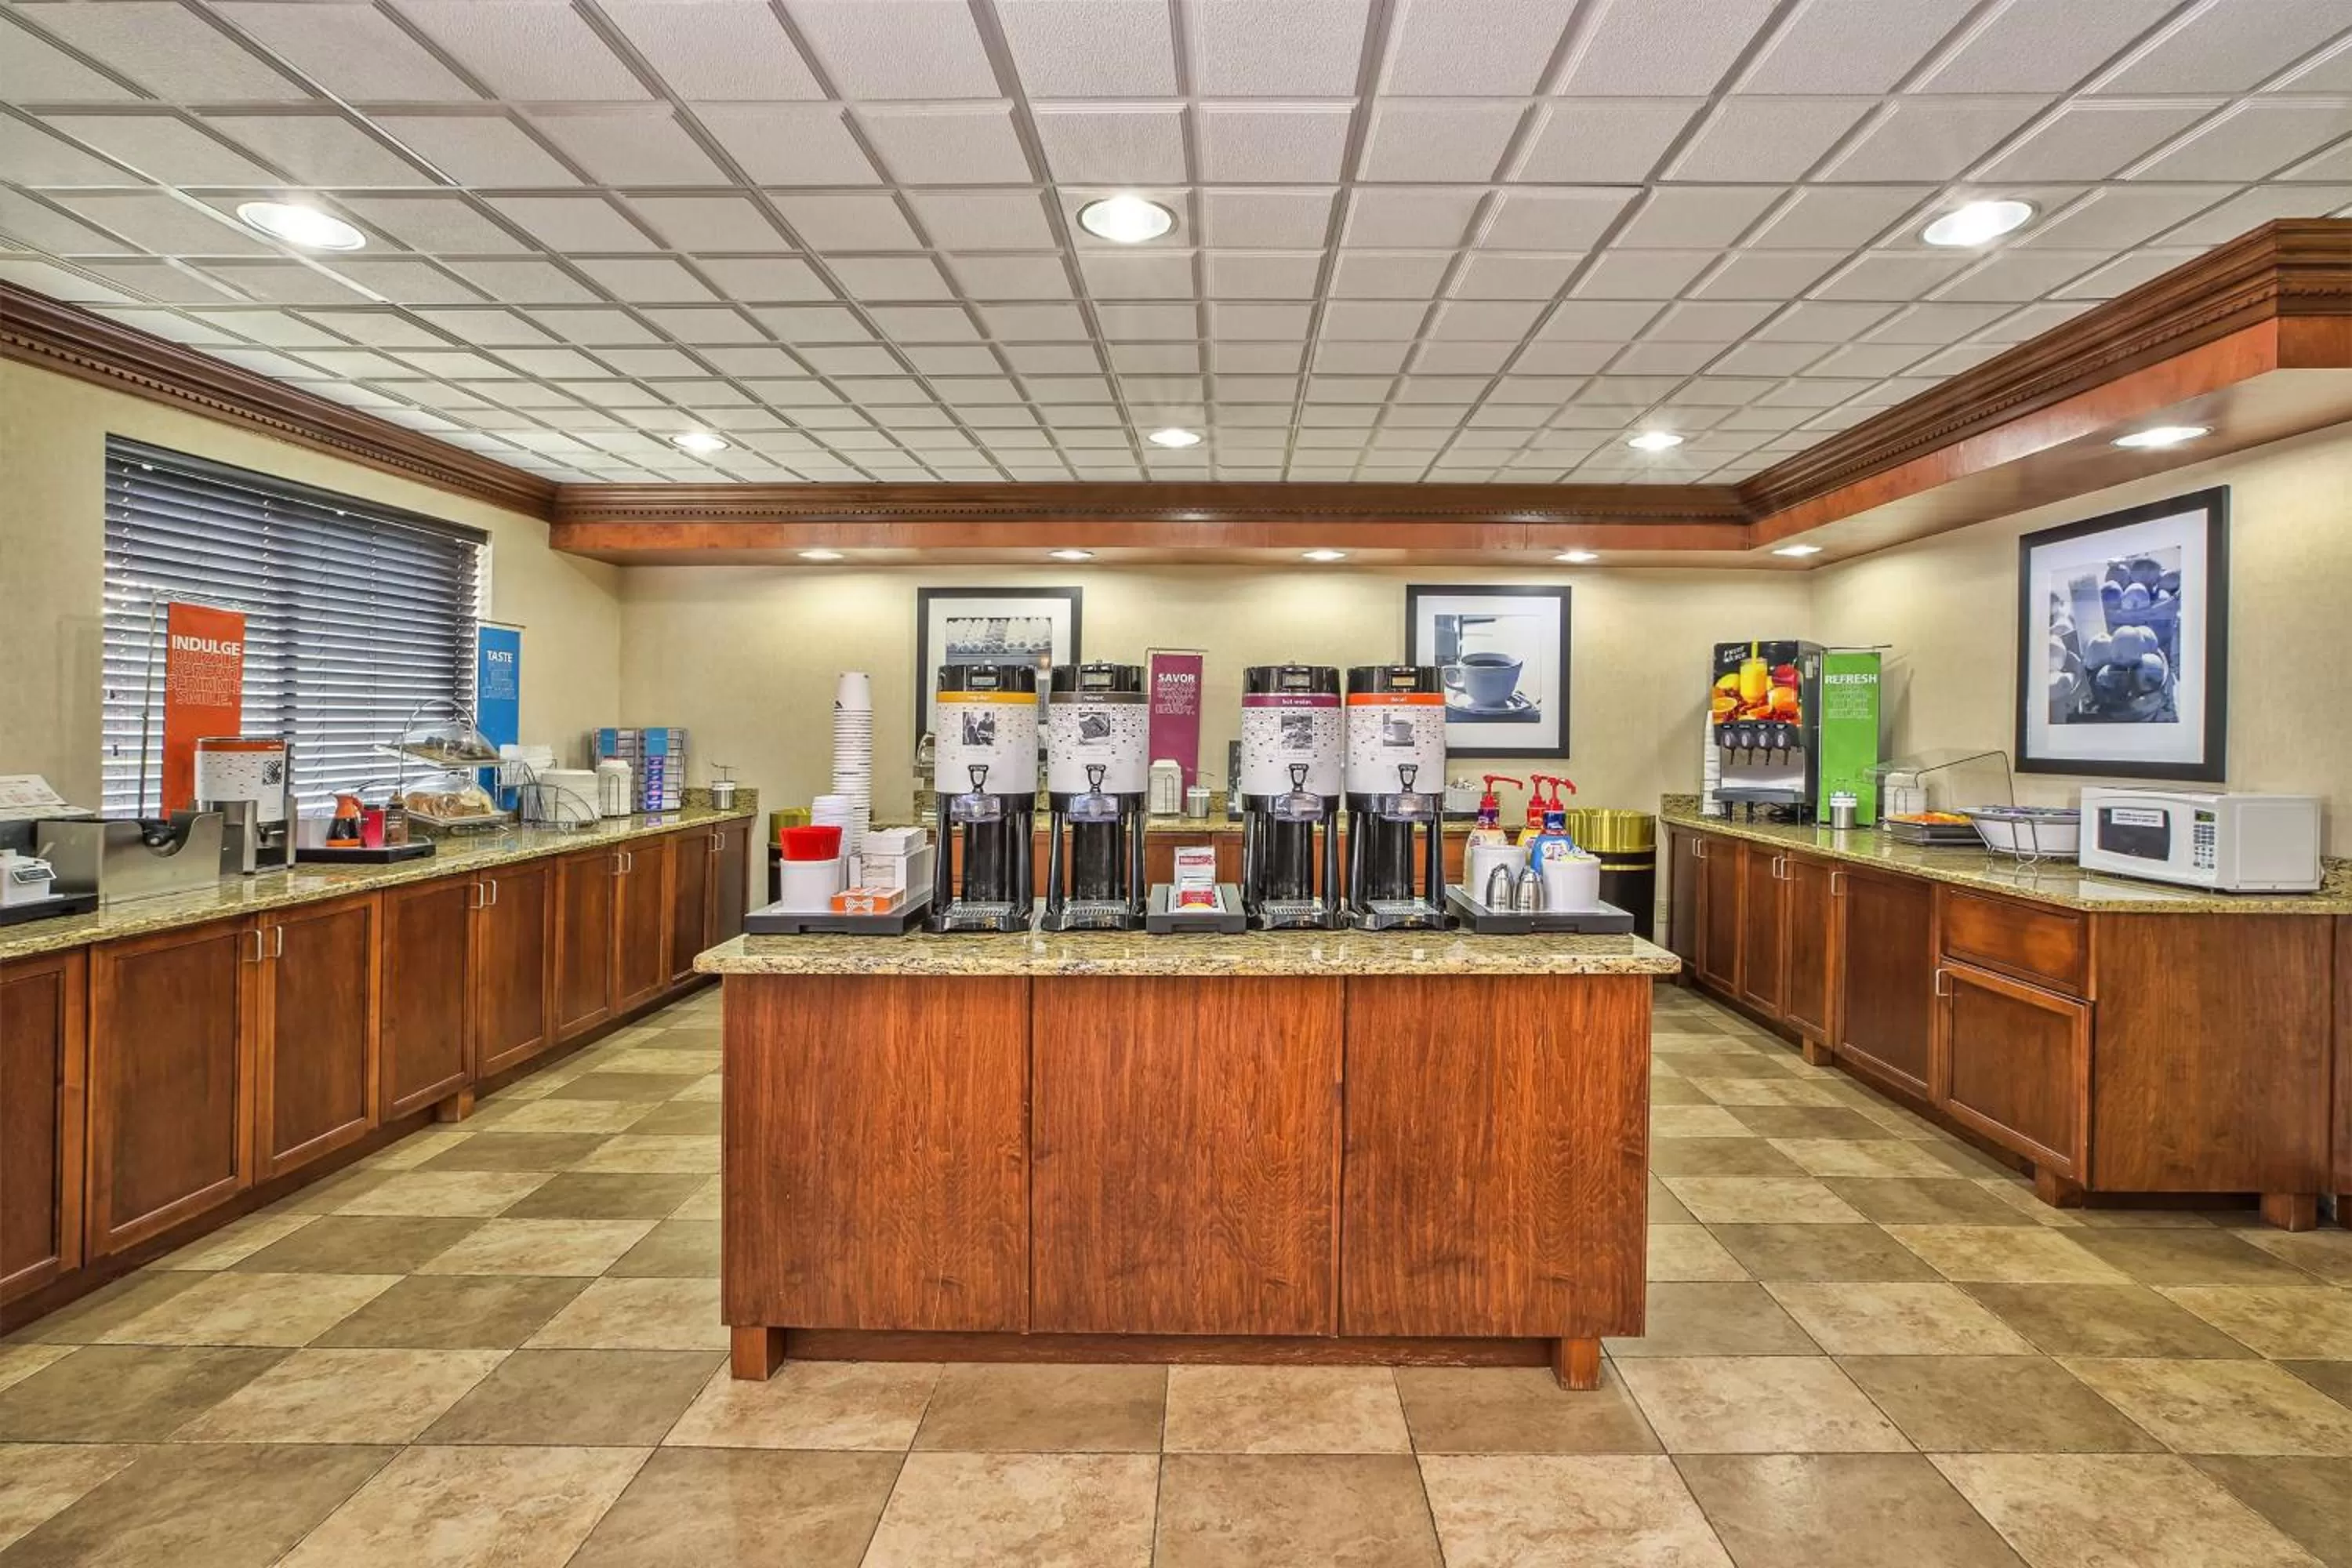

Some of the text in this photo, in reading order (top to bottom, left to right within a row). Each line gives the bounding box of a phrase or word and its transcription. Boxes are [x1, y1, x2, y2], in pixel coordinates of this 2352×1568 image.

[172, 634, 241, 655] INDULGE
[487, 649, 514, 662] TASTE
[1158, 673, 1196, 682] SAVOR
[1825, 673, 1878, 684] REFRESH
